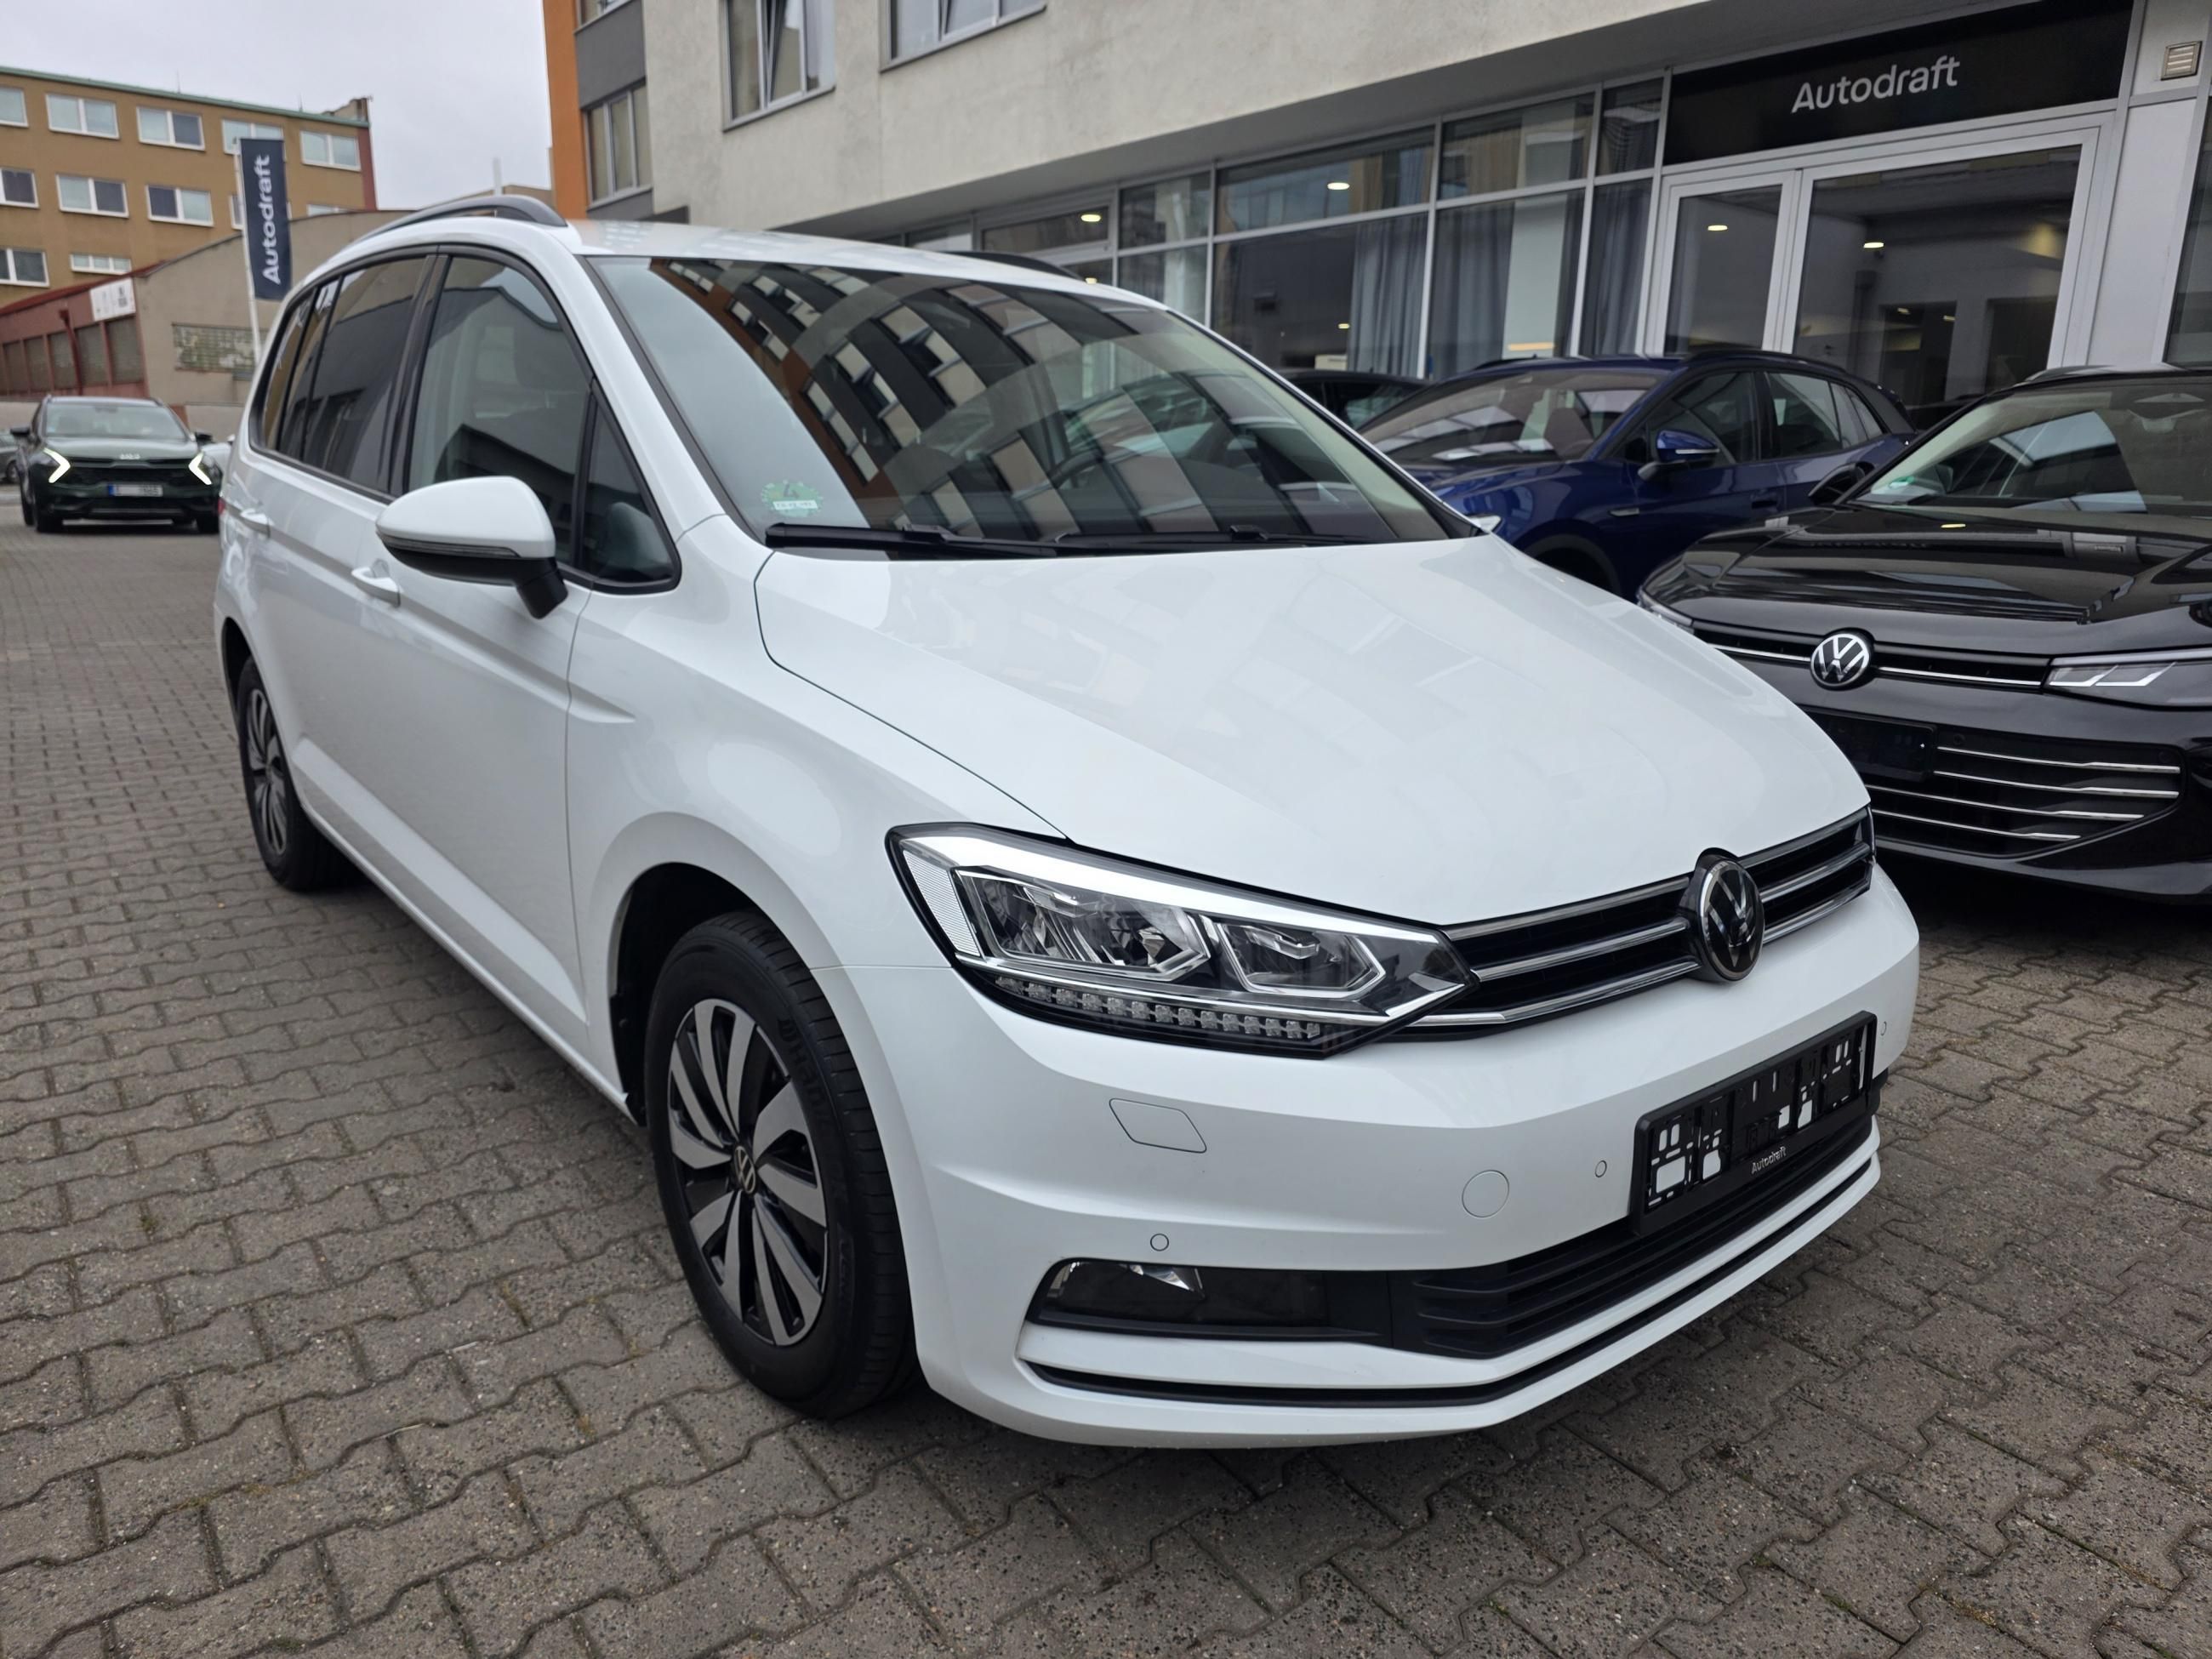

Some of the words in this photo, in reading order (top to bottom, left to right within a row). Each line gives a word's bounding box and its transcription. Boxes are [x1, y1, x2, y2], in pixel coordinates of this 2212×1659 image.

[1791, 55, 1960, 114] Autodraft
[254, 155, 282, 285] Autodraft
[1752, 1146, 1787, 1174] Autodraft
